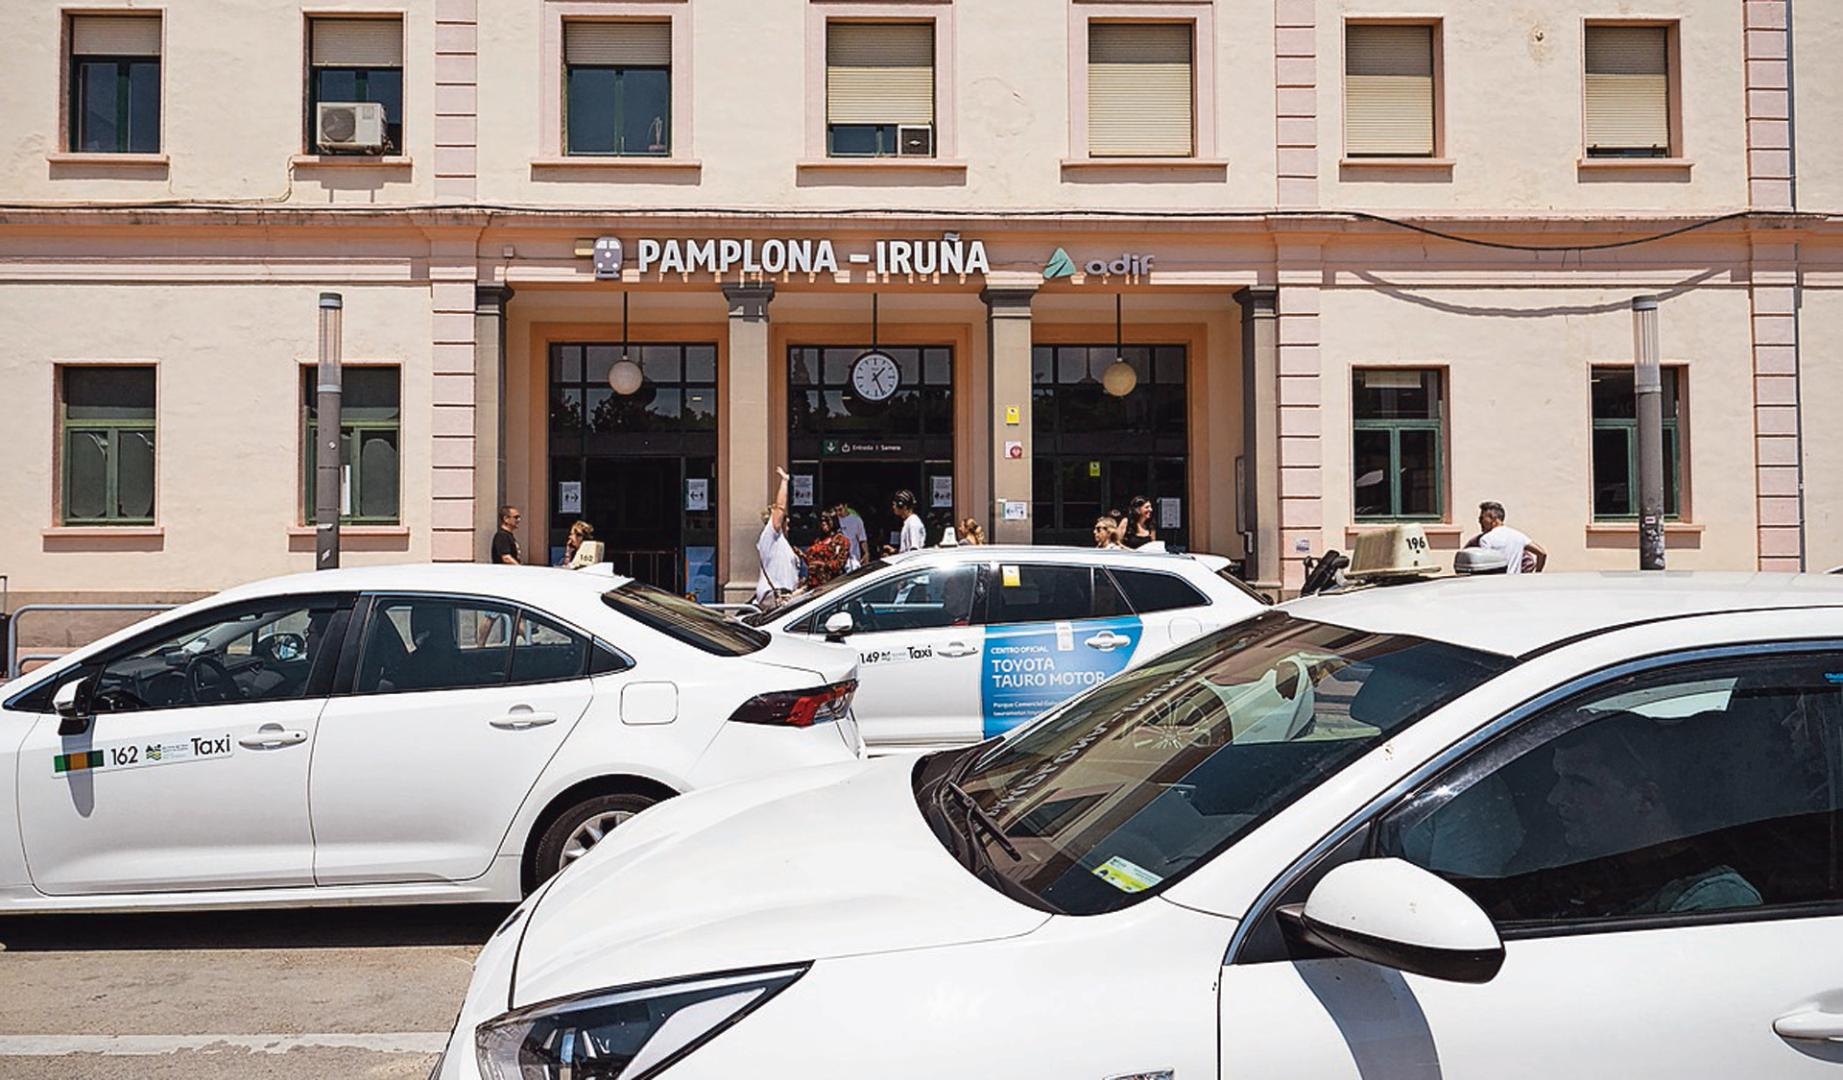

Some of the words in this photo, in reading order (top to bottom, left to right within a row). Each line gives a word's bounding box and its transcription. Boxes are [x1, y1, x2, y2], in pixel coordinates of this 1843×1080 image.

[638, 239, 838, 273] PAMPLONA
[876, 232, 990, 275] IRUÑA
[1084, 253, 1155, 276] adif
[1405, 536, 1426, 550] 196
[859, 651, 880, 664] 149
[906, 645, 933, 660] Taxi
[991, 646, 1019, 654] CENTRO
[992, 656, 1055, 673] TOYOTA
[992, 673, 1046, 688] TAURO
[1049, 671, 1105, 687] MOTOR
[110, 745, 139, 766] 162
[190, 733, 231, 756] Taxi
